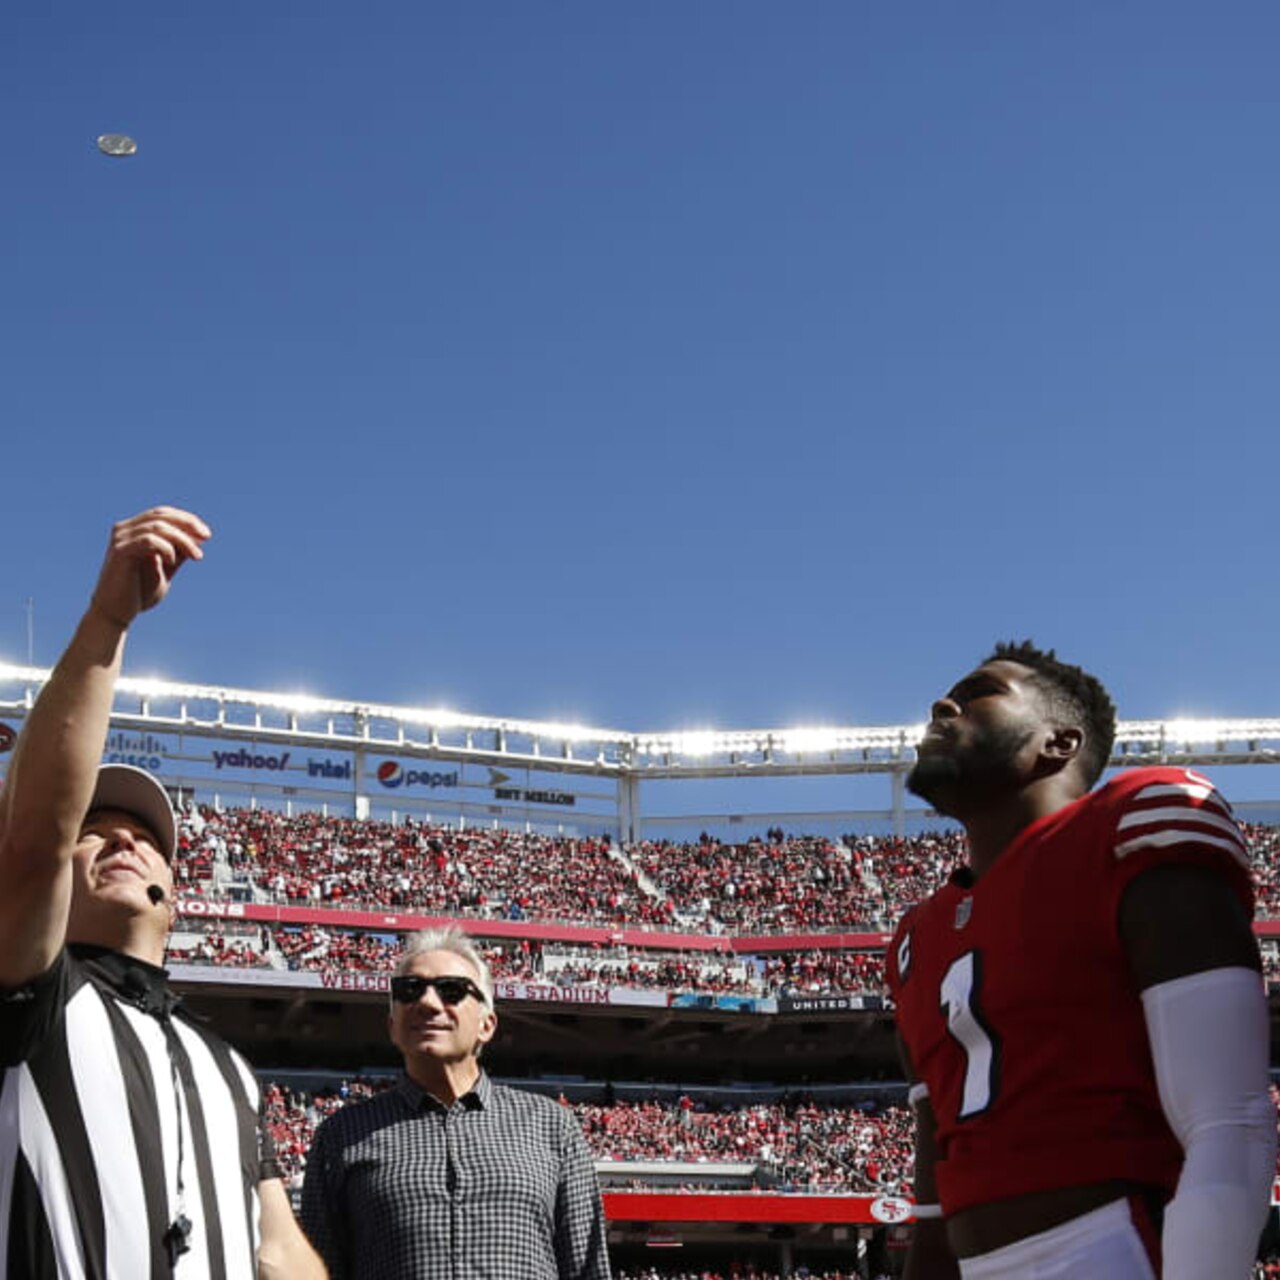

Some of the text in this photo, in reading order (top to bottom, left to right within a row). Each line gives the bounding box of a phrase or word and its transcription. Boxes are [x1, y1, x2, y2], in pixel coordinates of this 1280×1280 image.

[212, 749, 290, 771] yahoo!
[307, 759, 351, 779] intel
[405, 769, 458, 788] pepsi
[321, 974, 389, 991] WELCO
[494, 983, 610, 1005] I'S STADIUM
[793, 1000, 847, 1010] UNITED
[940, 951, 993, 1118] 1
